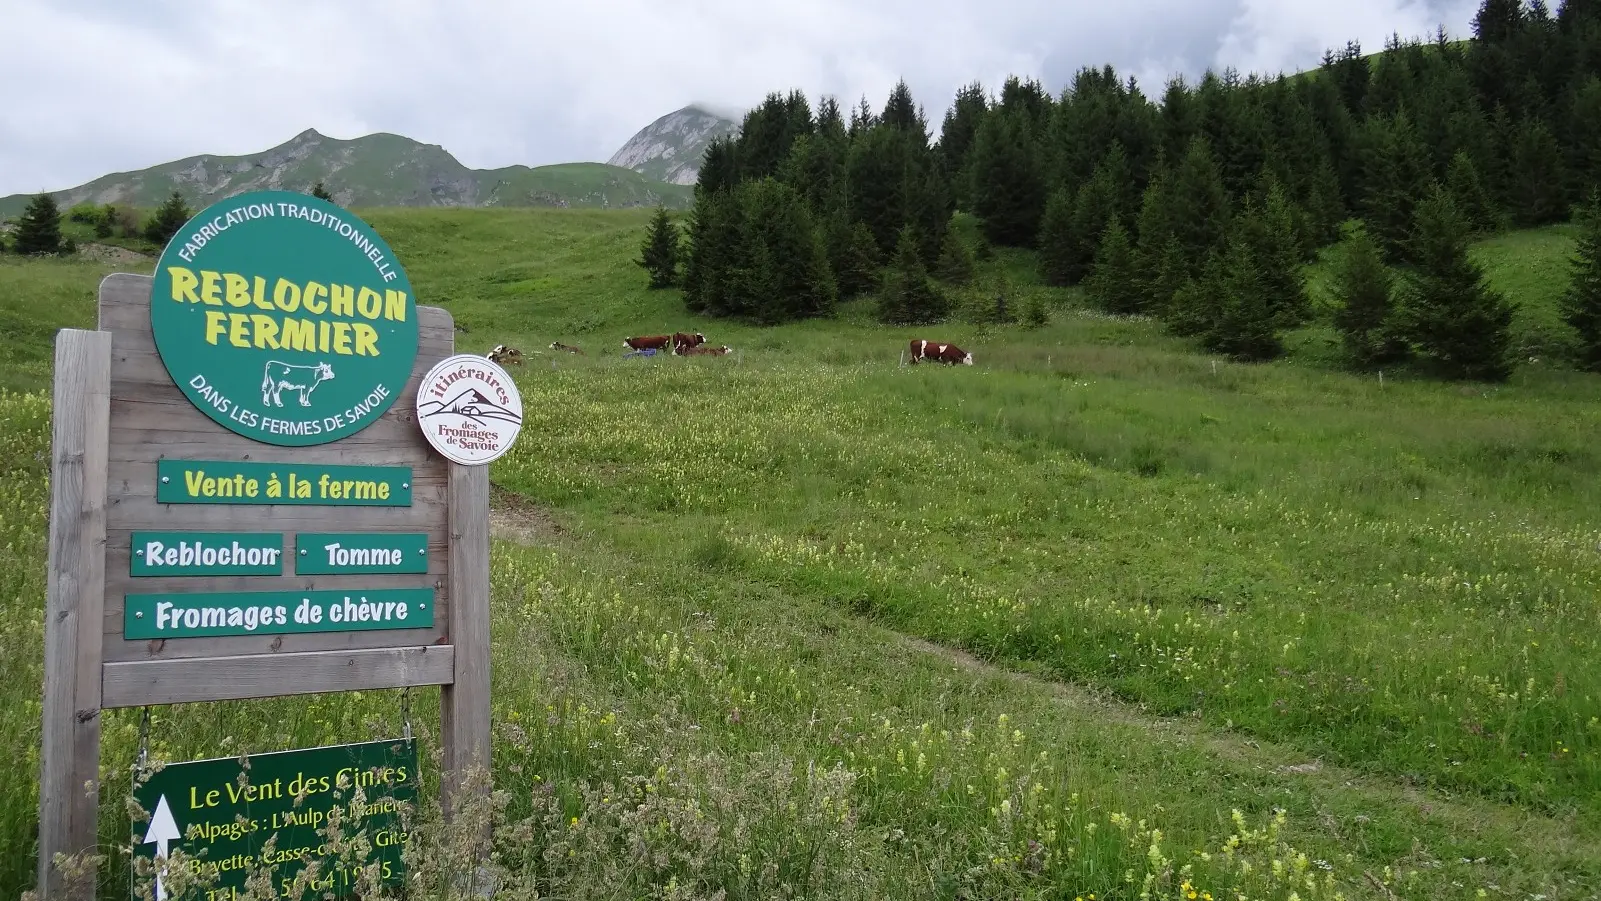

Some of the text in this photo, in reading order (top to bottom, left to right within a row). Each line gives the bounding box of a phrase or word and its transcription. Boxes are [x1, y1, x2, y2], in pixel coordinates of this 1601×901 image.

[178, 203, 397, 283] FABRICATION TRADITIONNELLE
[167, 267, 406, 322] REBLOCHON
[205, 310, 380, 356] FERMIER
[430, 365, 509, 406] itinéraires
[189, 374, 390, 435] DANS LES FERMES DE SAVOIE
[438, 424, 498, 442] Fromages
[461, 421, 477, 430] des
[446, 436, 499, 451] de Savoie
[185, 470, 390, 500] Vente à la ferme
[145, 541, 276, 566] Reblochon
[325, 543, 402, 566] Tomme
[156, 596, 408, 630] Fromages de chèvre
[190, 786, 220, 809] Le
[225, 777, 281, 804] Vent
[289, 772, 330, 798] des
[272, 808, 322, 830] L'Aulp
[281, 878, 304, 897] 5
